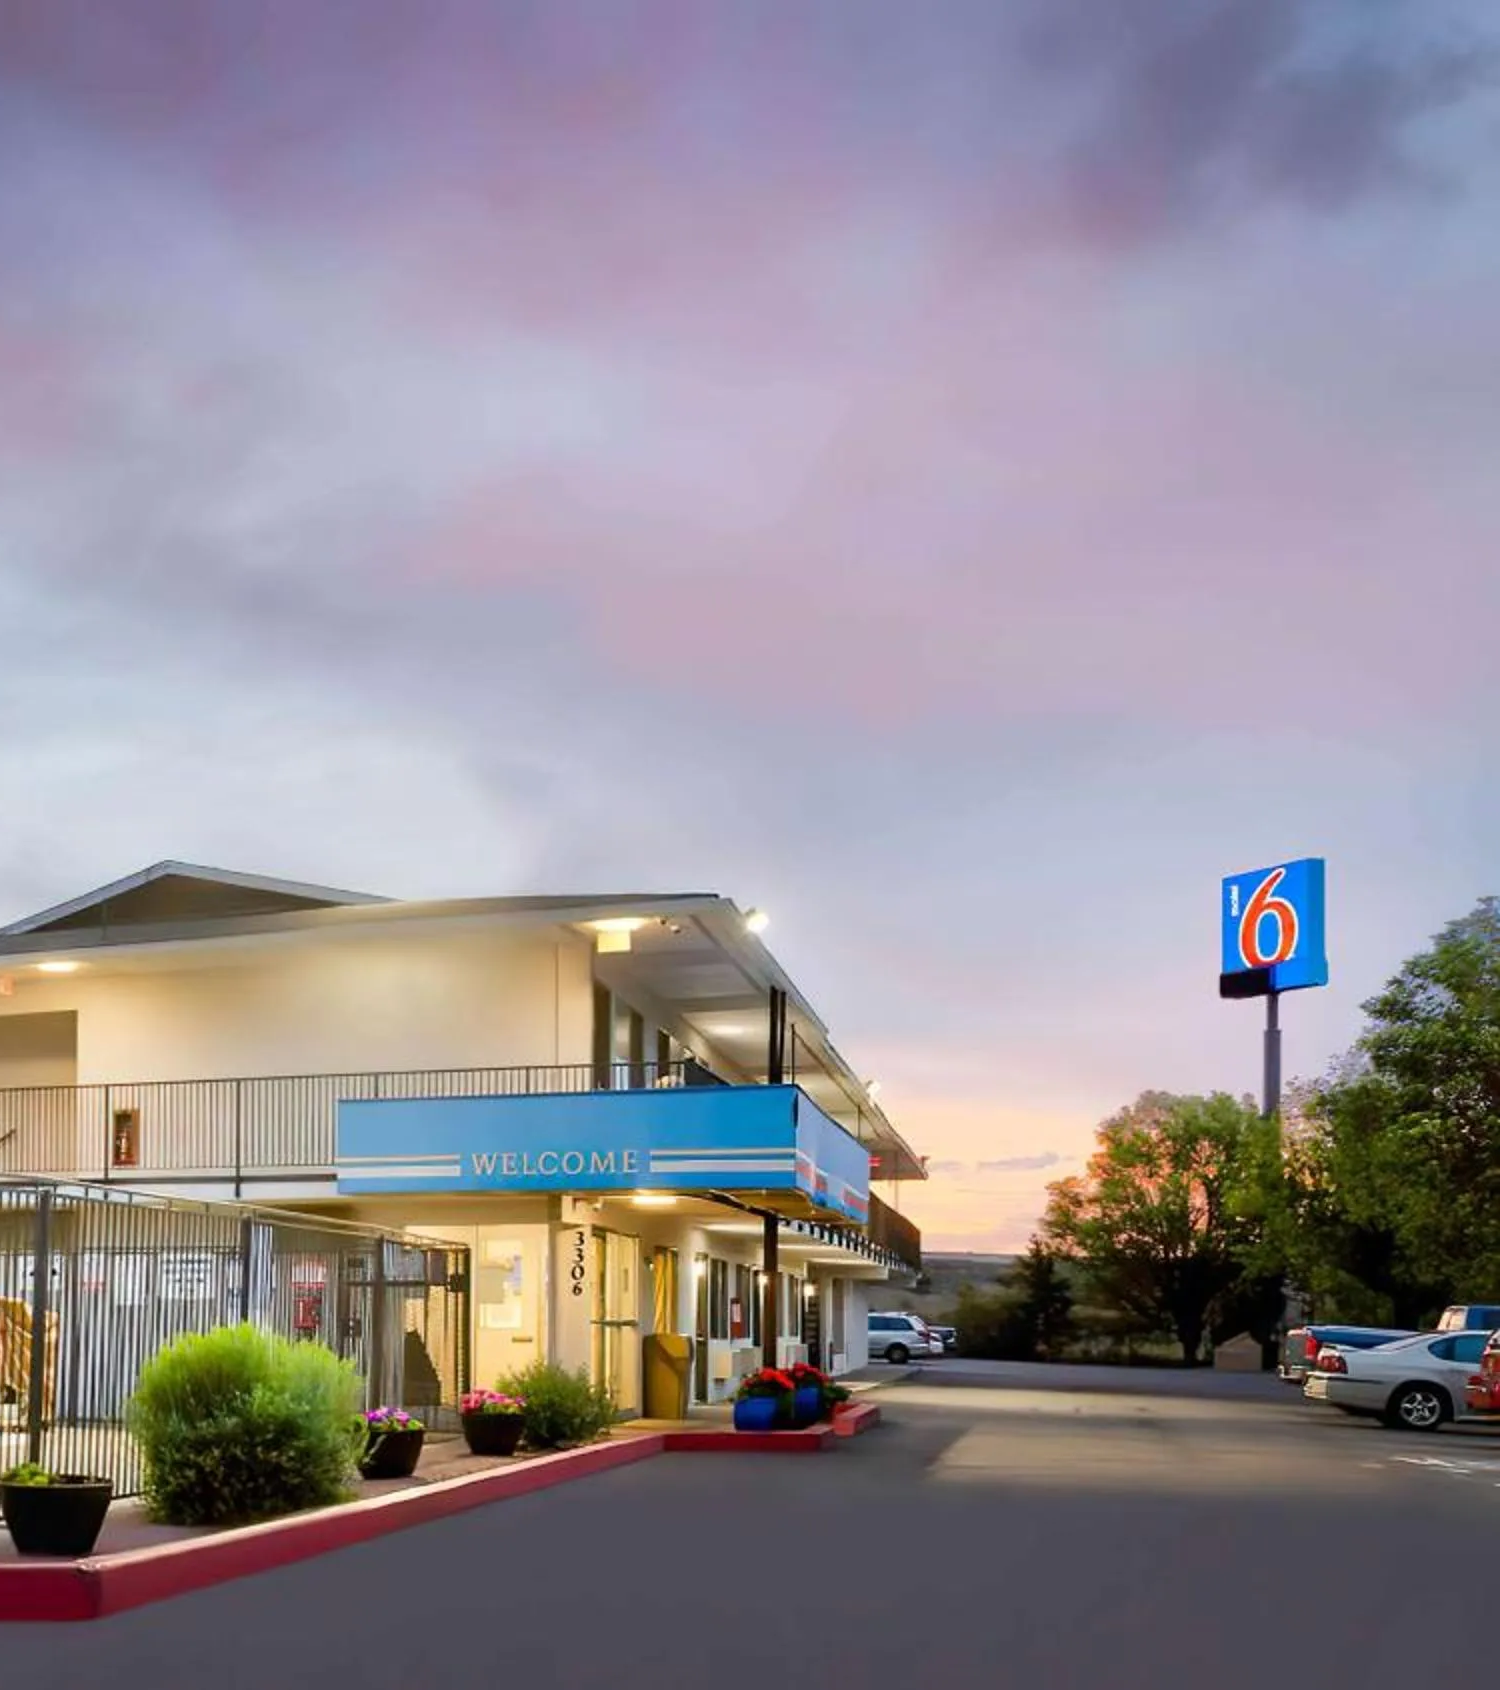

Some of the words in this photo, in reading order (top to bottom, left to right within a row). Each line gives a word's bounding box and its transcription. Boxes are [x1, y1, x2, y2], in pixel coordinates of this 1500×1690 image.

[1238, 867, 1299, 969] 6
[471, 1150, 639, 1176] WELCOME
[571, 1231, 585, 1297] 3306
